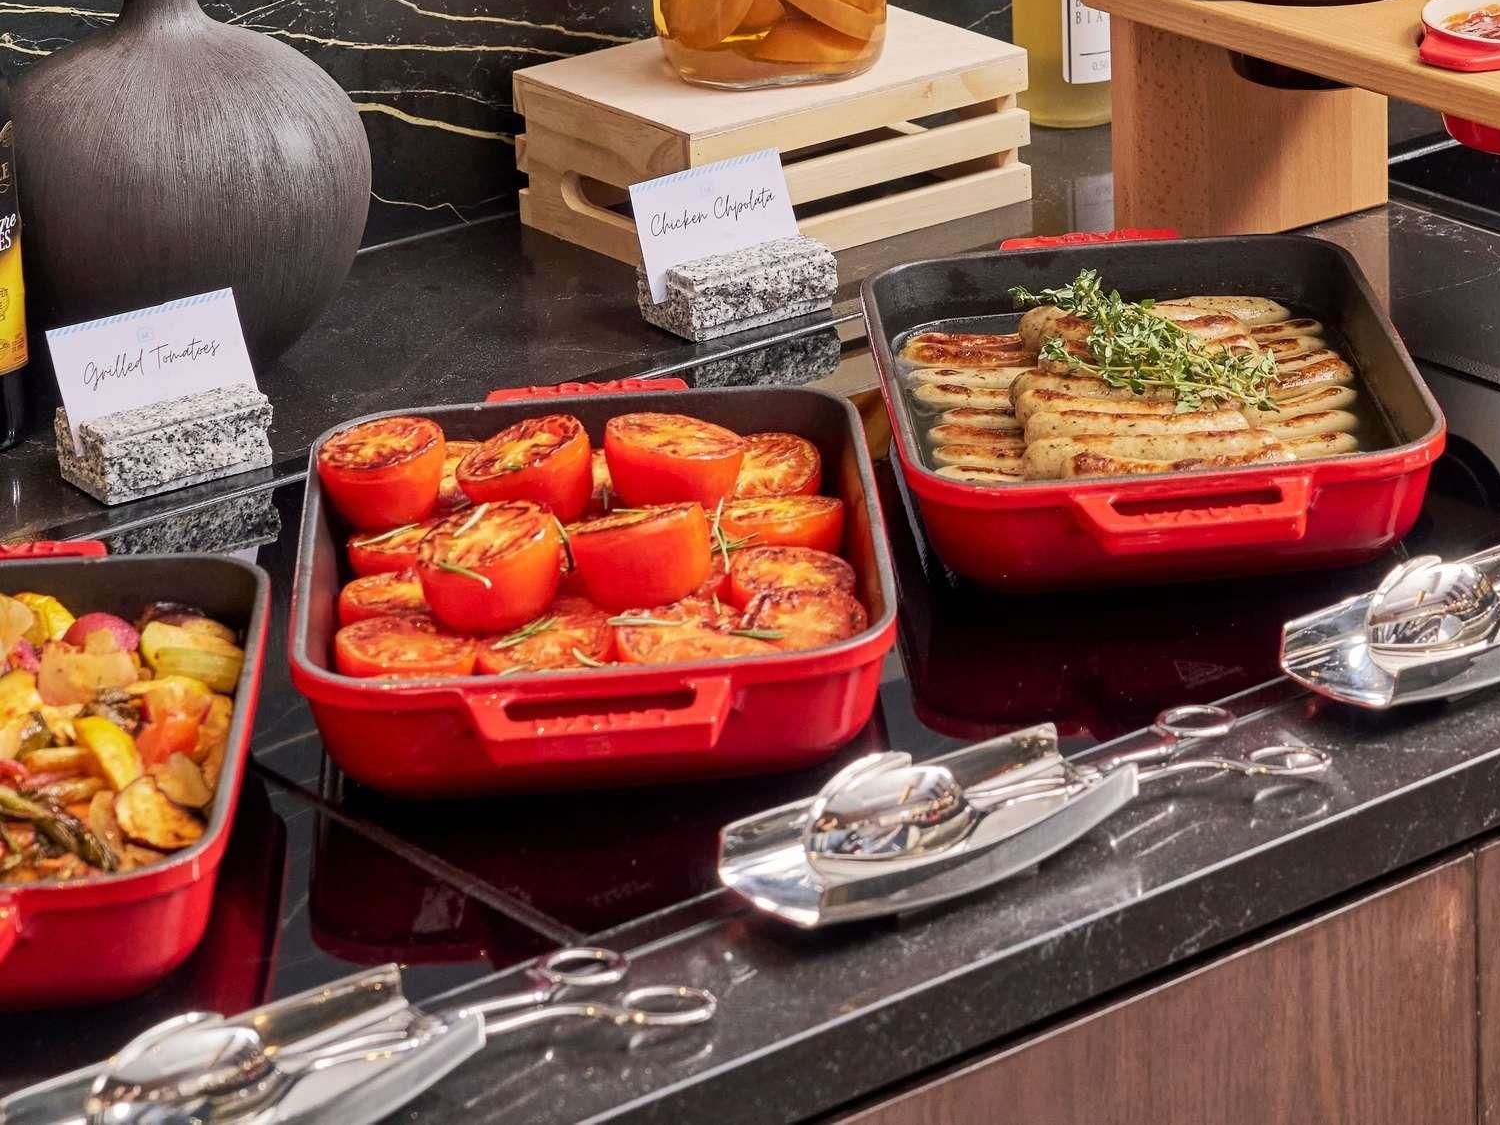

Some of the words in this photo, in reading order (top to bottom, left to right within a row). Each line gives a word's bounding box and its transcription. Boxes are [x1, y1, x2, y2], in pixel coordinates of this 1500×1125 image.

[651, 209, 709, 236] Chicken
[83, 348, 145, 391] Grilled
[149, 338, 221, 369] Tomatoes
